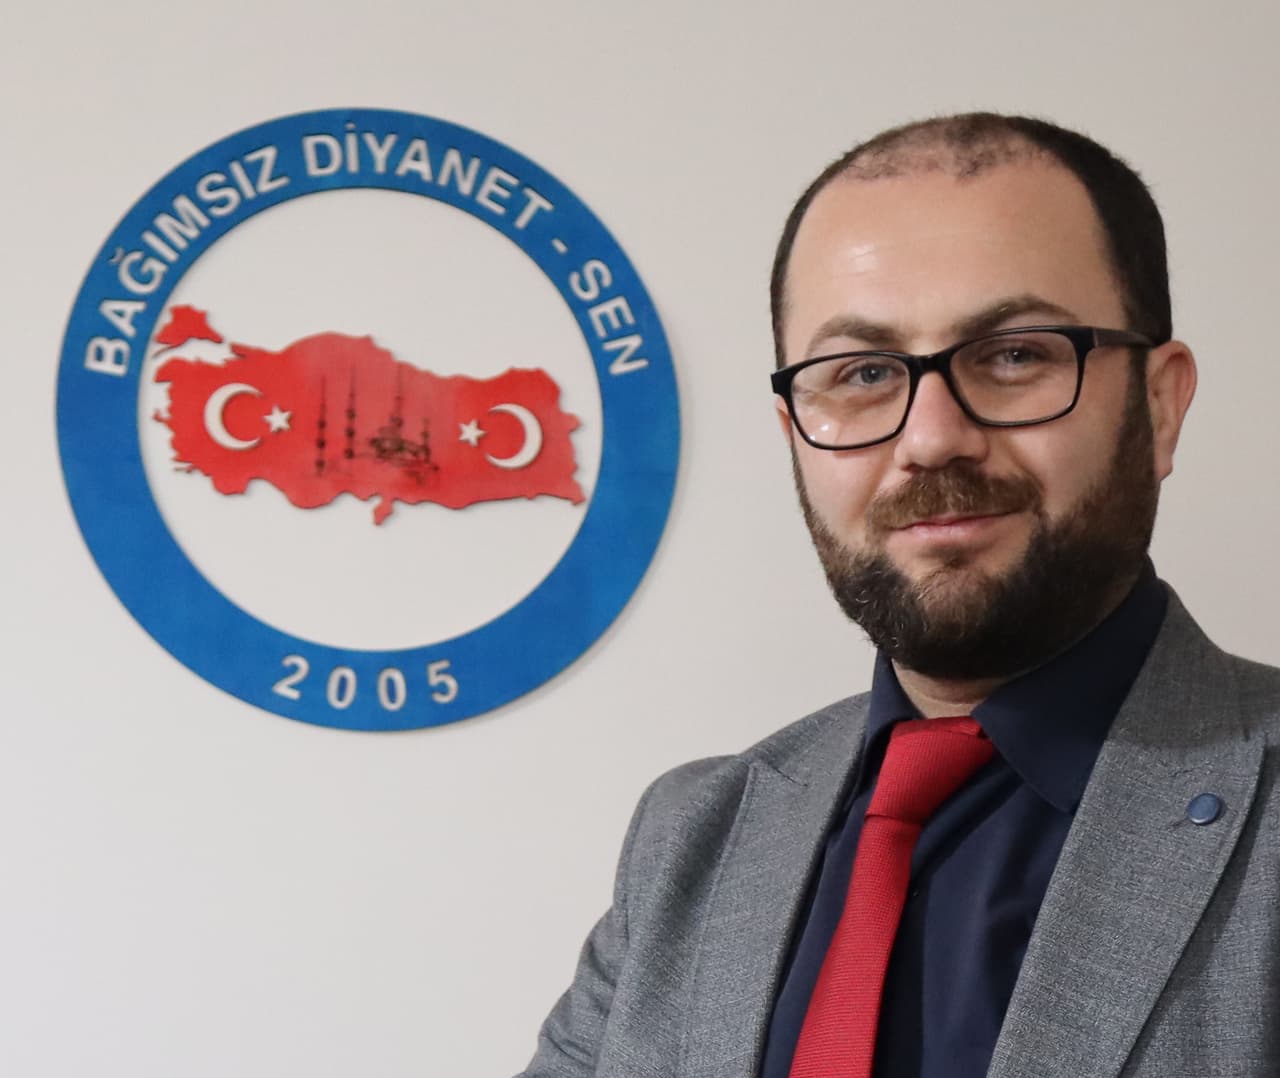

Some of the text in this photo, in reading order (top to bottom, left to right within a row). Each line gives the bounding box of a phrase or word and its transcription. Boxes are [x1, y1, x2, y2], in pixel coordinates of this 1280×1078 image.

[83, 145, 290, 377] BAĞIMSIZ
[302, 121, 554, 230] DİYANET
[569, 259, 650, 376] SEN
[272, 654, 459, 712] 2005
